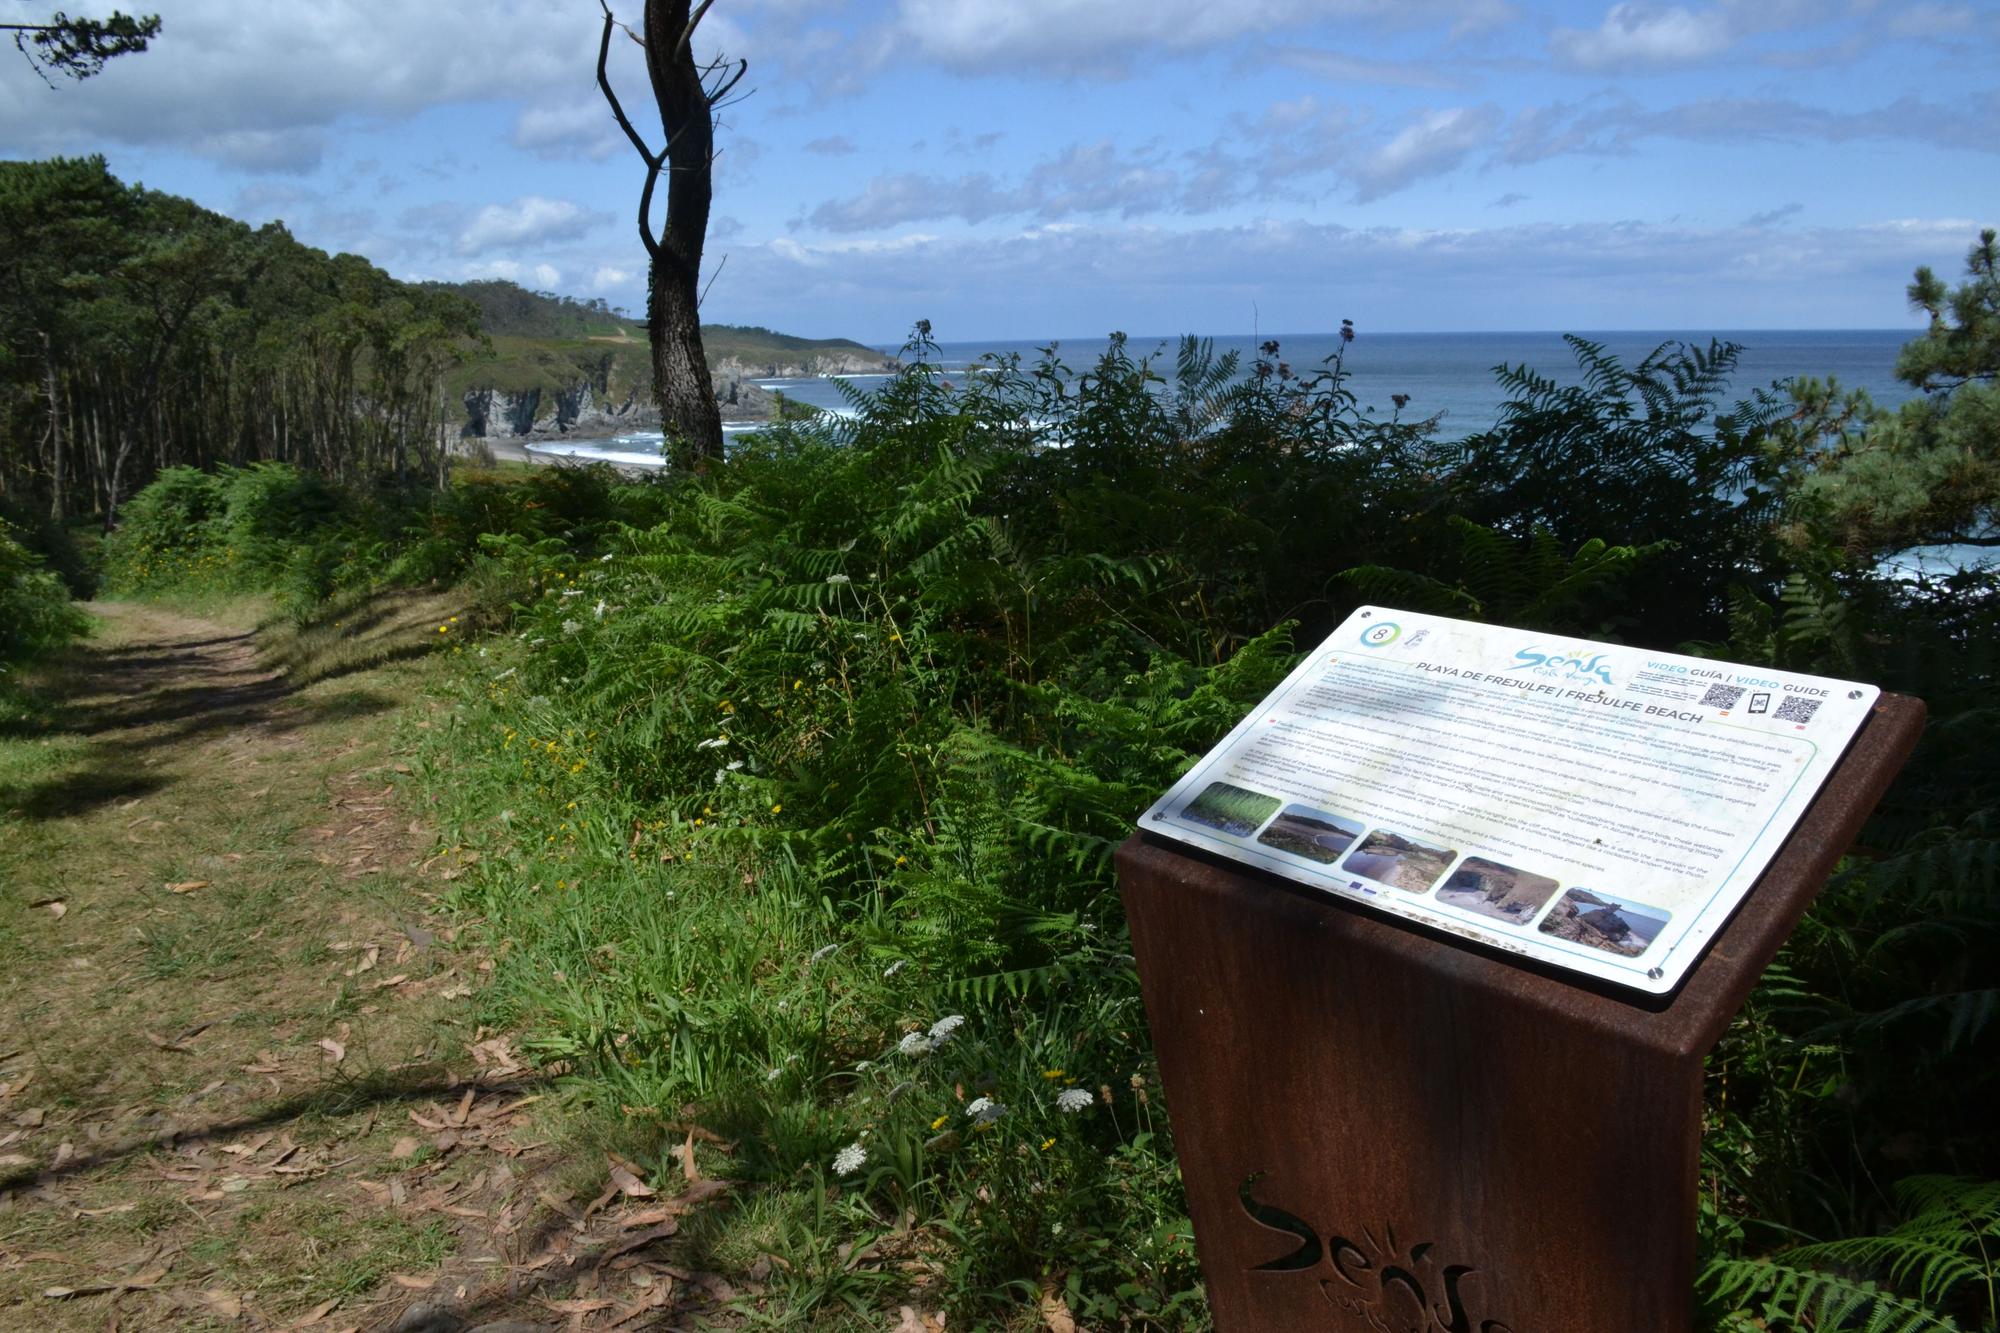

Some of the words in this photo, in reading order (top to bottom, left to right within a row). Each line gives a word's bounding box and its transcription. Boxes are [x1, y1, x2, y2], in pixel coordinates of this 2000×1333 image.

[1373, 629, 1388, 640] 8
[1503, 645, 1616, 686] Senda
[1648, 661, 1688, 674] VIDEO
[1690, 668, 1723, 680] GUÍA
[1736, 676, 1780, 689] VIDEO
[1783, 684, 1831, 698] GUIDE
[1416, 662, 1458, 678] PLAYA
[1462, 670, 1483, 681] DE
[1484, 674, 1556, 695] FREJULFE
[1564, 690, 1643, 712] FREJULFE
[1644, 705, 1704, 724] BEACH
